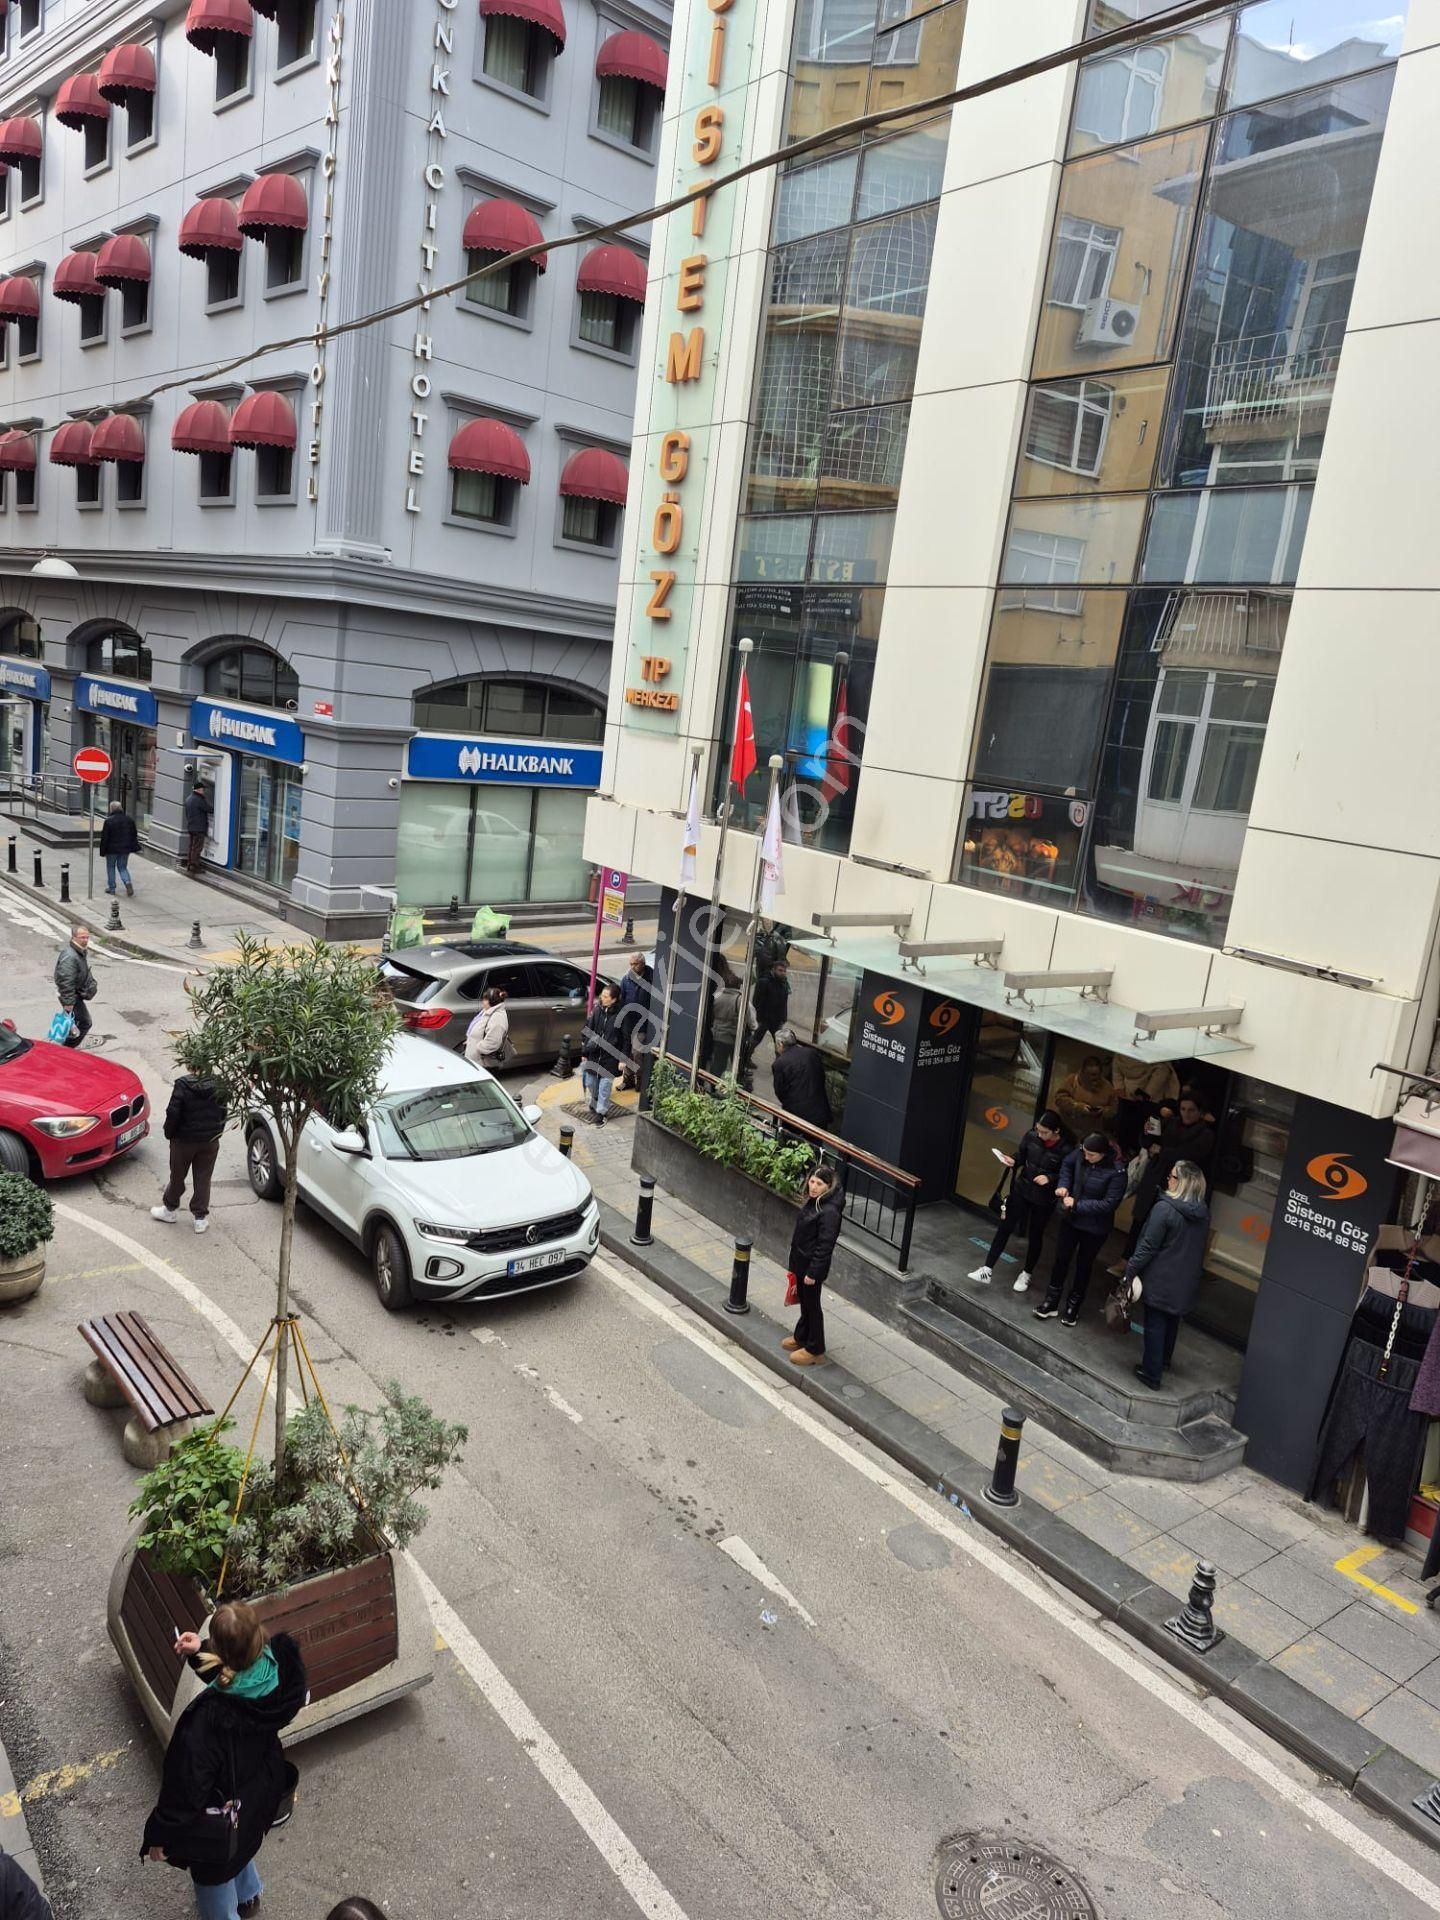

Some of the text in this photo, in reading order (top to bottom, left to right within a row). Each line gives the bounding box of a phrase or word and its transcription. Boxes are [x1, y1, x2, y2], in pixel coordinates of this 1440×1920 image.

[318, 155, 338, 299] CITY
[415, 163, 445, 311] CITY
[645, 0, 736, 621] İSTEM GÖZ
[305, 323, 328, 502] HOTEL
[405, 332, 432, 513] HOTEL
[640, 656, 672, 683] TIP
[221, 717, 276, 745] HALKBANK
[482, 752, 574, 776] HALKBANK
[863, 1029, 905, 1053] Sistem Göz
[919, 1046, 944, 1057] Sistem
[1289, 1189, 1310, 1205] ÖZEL
[1285, 1214, 1310, 1231] 0216
[1313, 1226, 1332, 1240] 354
[1287, 1199, 1369, 1243] Sistem Göz
[516, 1252, 563, 1272] 34 HEC 097
